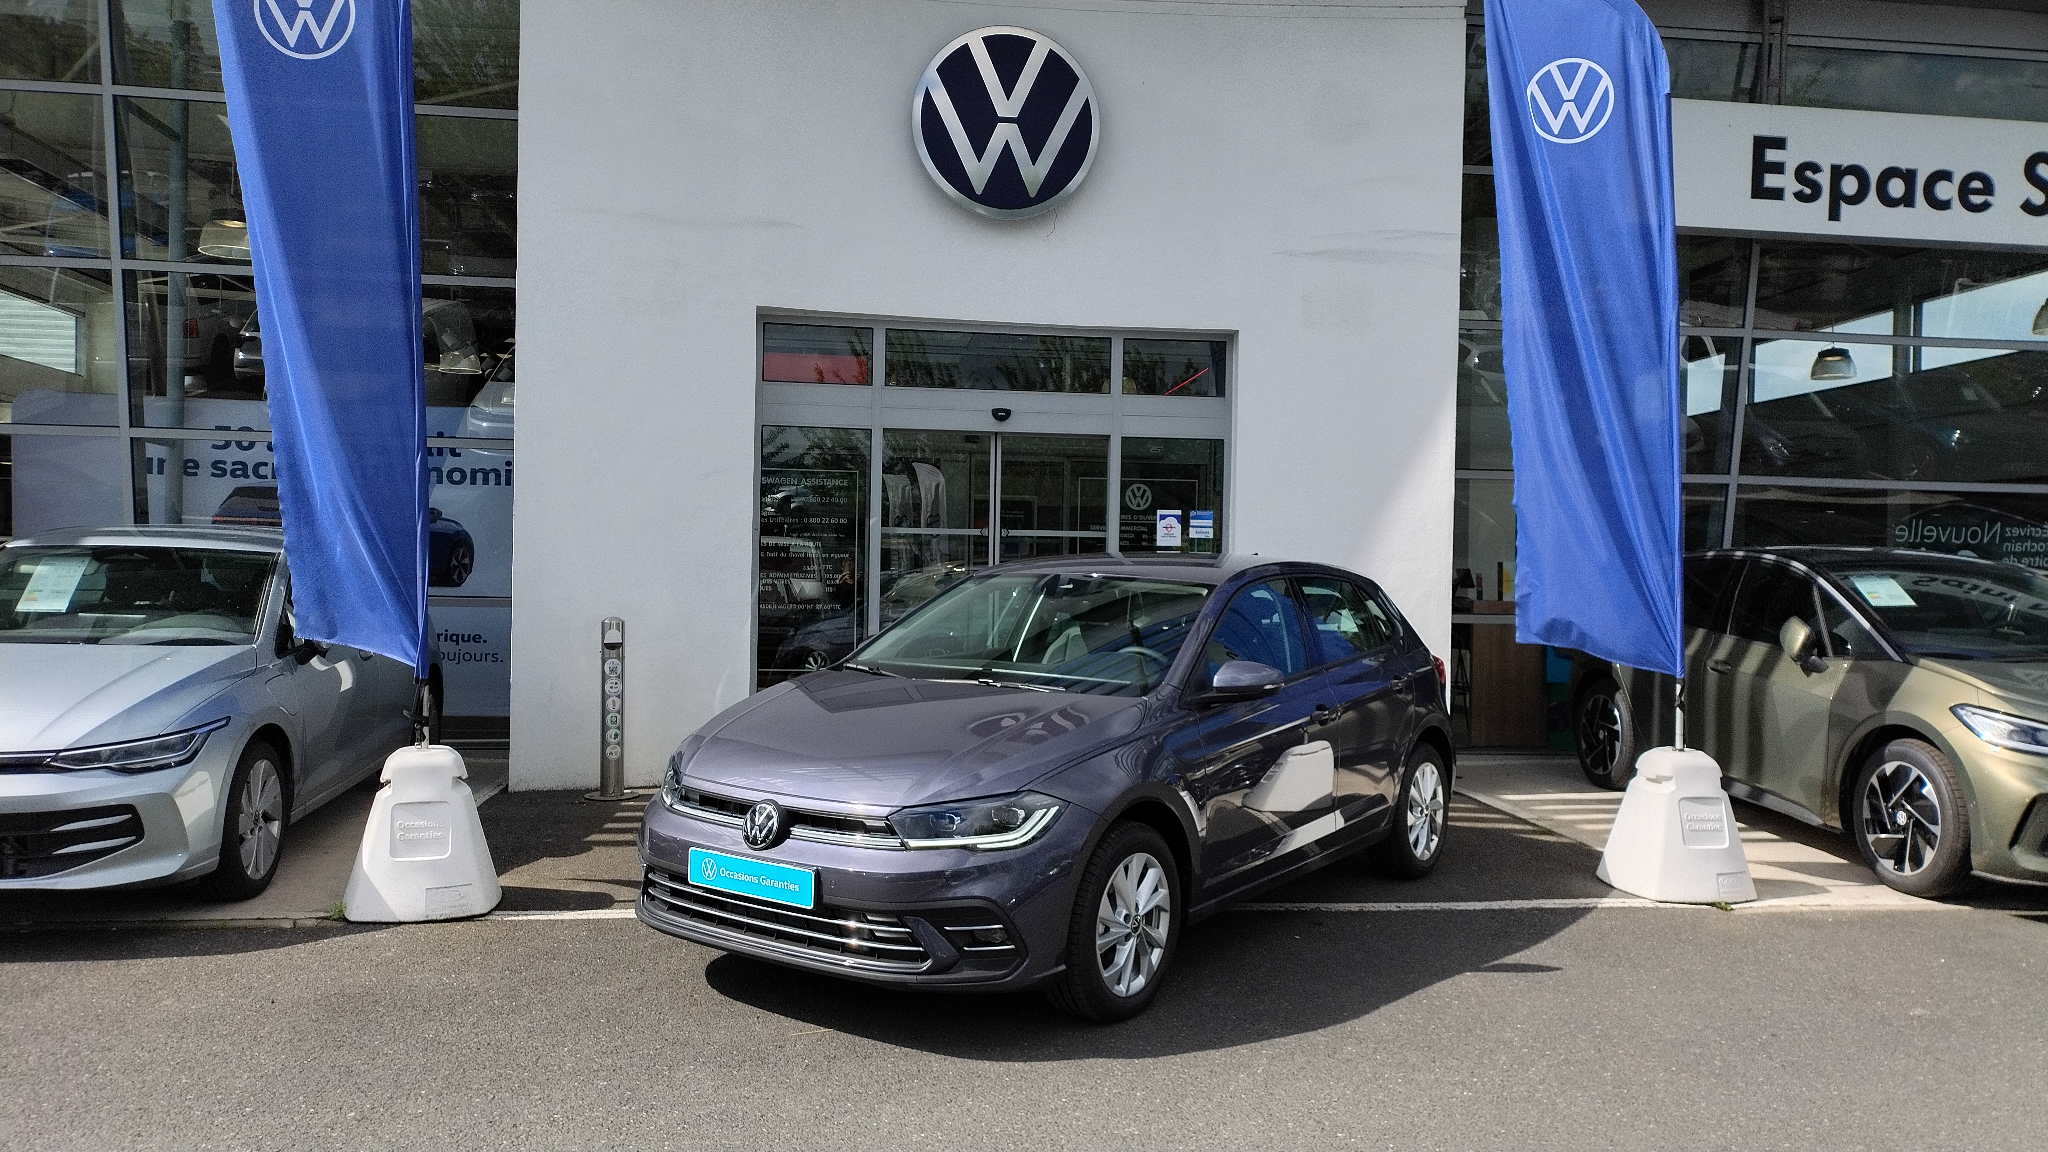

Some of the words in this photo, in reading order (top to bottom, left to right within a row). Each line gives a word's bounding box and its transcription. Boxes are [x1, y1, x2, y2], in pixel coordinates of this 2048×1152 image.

[1750, 134, 1996, 222] Espace
[210, 458, 278, 480] sac
[761, 476, 798, 485] SWAGEN
[800, 477, 848, 487] ASSISTANCE
[396, 819, 446, 830] Occasions
[396, 830, 444, 841] Garanties
[719, 866, 759, 884] Occasions
[759, 875, 800, 892] Garanties
